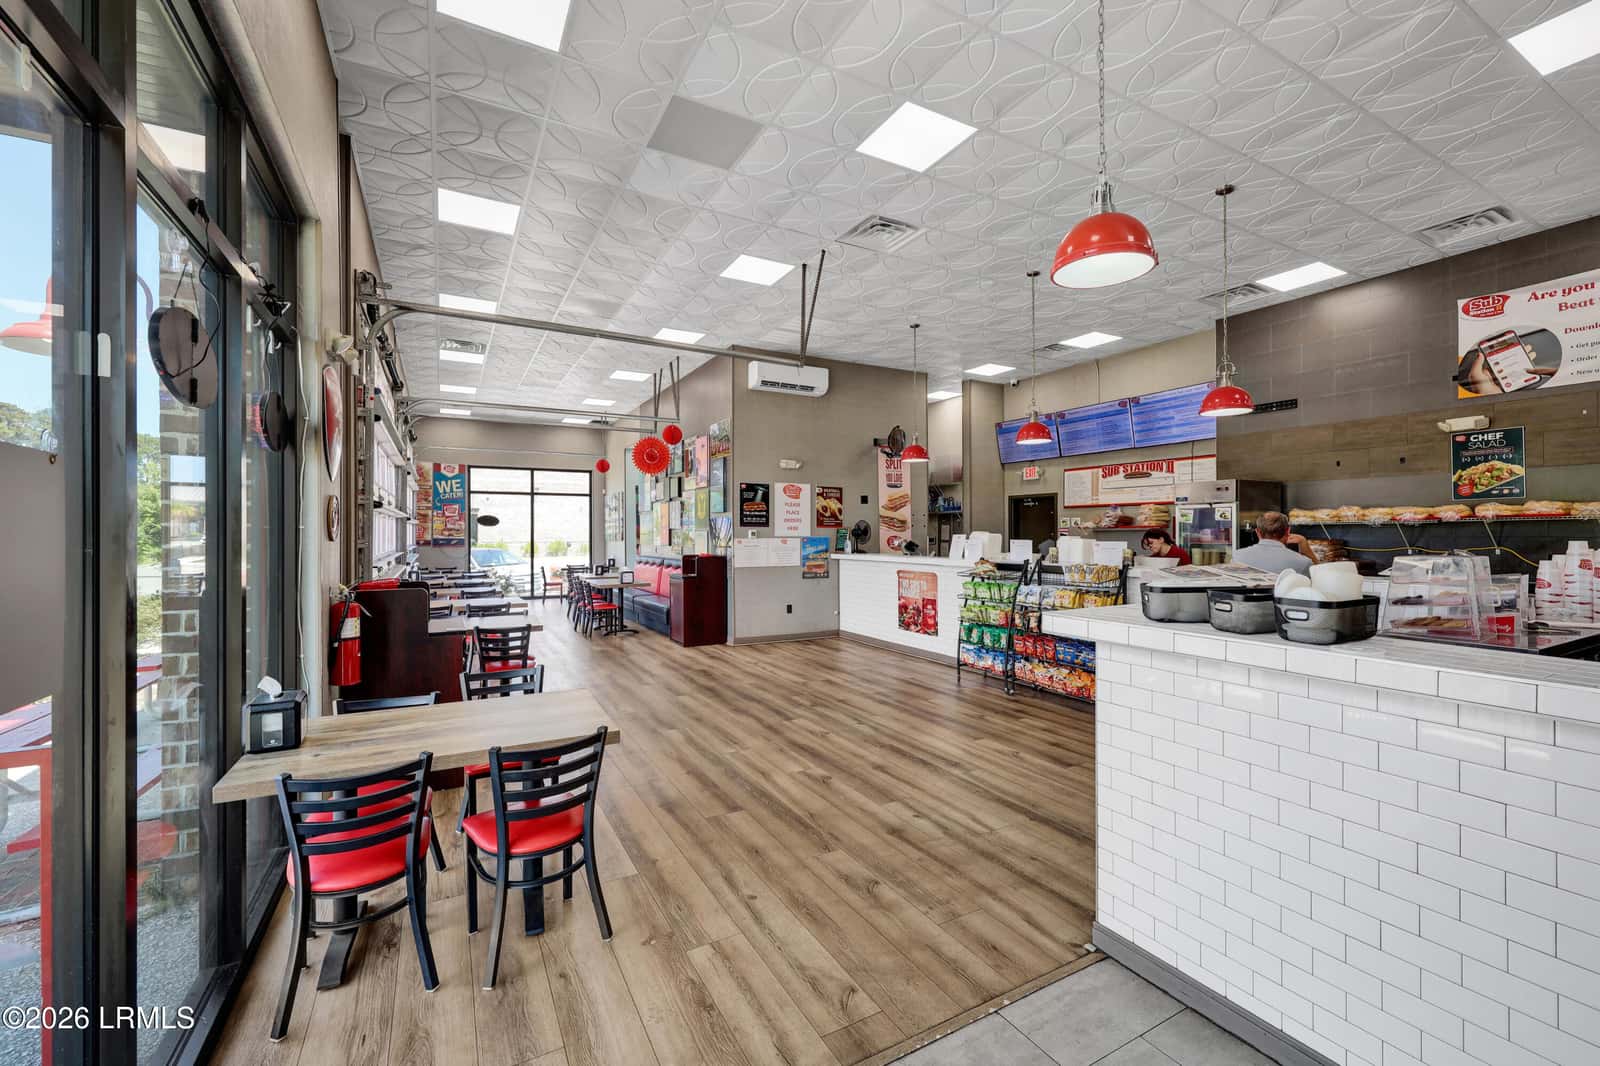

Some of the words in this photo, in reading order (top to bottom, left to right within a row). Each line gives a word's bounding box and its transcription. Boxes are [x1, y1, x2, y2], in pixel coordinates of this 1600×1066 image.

[1527, 290, 1558, 303] Are
[1561, 281, 1596, 297] you
[1557, 297, 1596, 313] Beat
[1470, 431, 1505, 442] CHEF
[1468, 439, 1507, 450] SALAD
[885, 458, 902, 470] SPLIT
[1101, 463, 1121, 479] SUB
[1122, 460, 1165, 475] STATION
[1165, 459, 1175, 474] II
[1025, 466, 1037, 479] EXIT
[435, 479, 463, 494] WE
